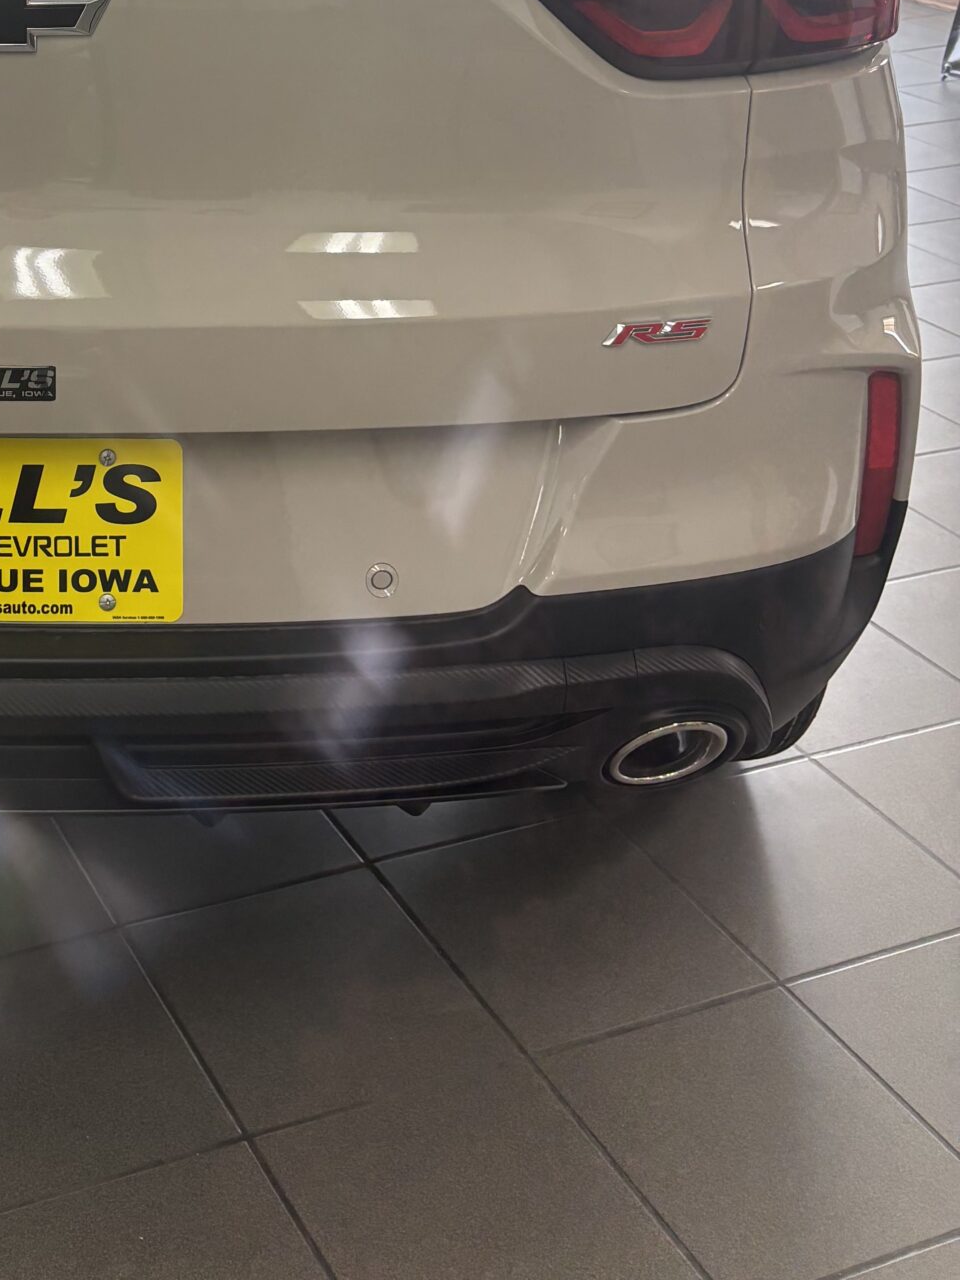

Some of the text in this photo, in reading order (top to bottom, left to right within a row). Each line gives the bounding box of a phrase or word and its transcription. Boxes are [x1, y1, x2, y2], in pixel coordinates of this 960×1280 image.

[601, 318, 712, 346] RS
[21, 390, 54, 398] IOWA
[58, 568, 159, 594] IOWA
